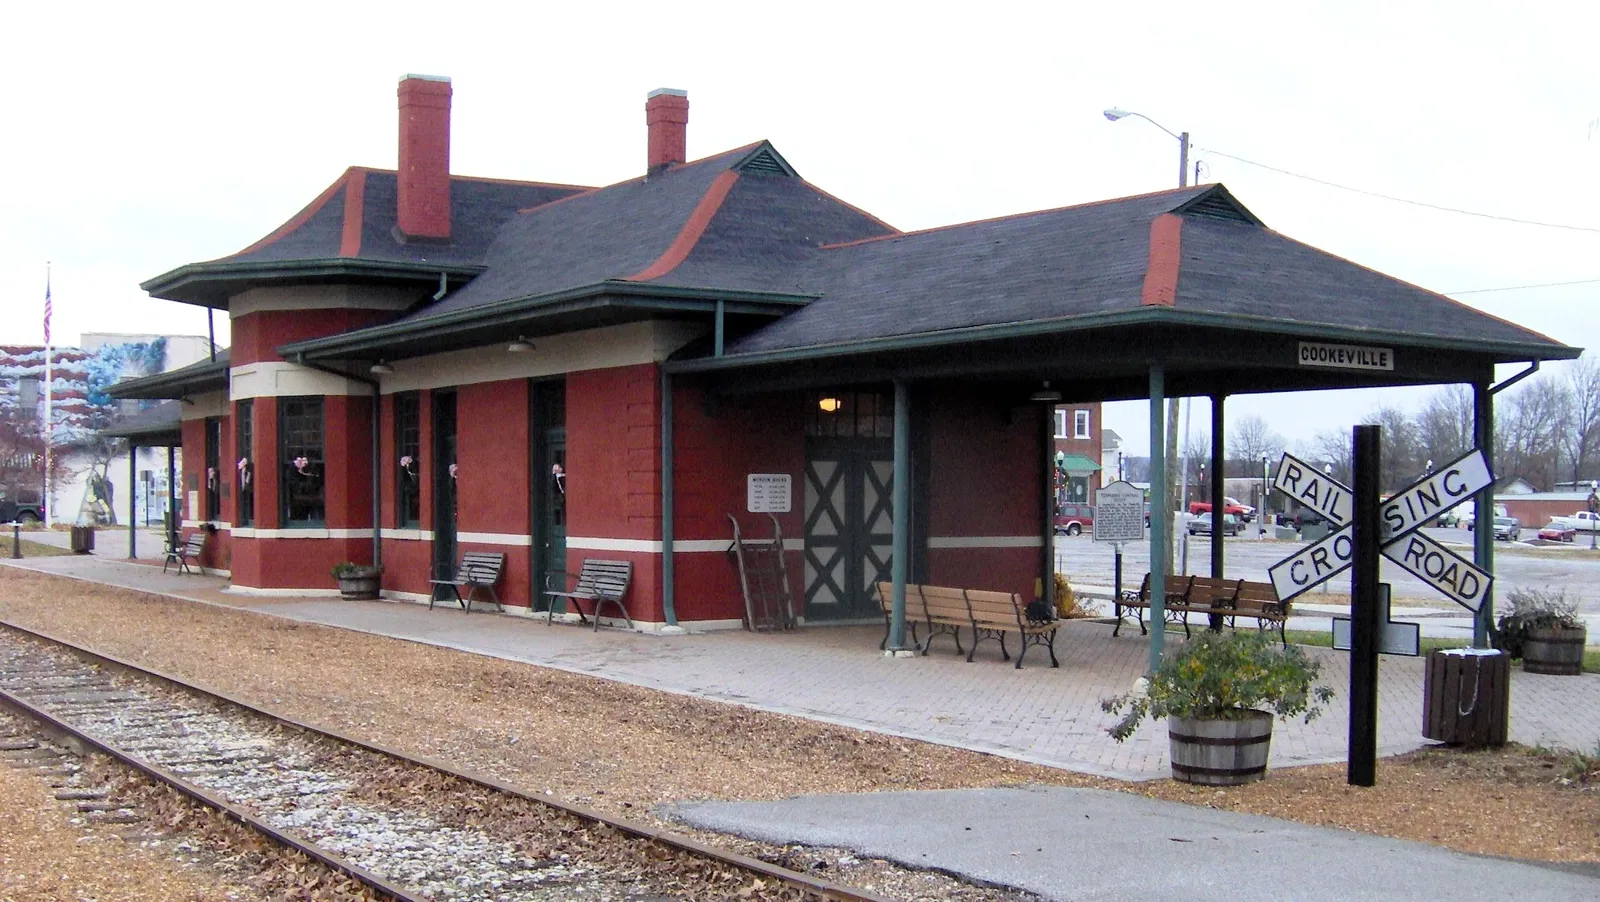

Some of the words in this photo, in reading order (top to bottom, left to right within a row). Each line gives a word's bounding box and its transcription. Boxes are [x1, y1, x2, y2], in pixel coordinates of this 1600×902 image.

[1301, 346, 1387, 367] COOKEVILLE
[1283, 464, 1343, 522] RAIL
[1404, 537, 1480, 600] ROAD
